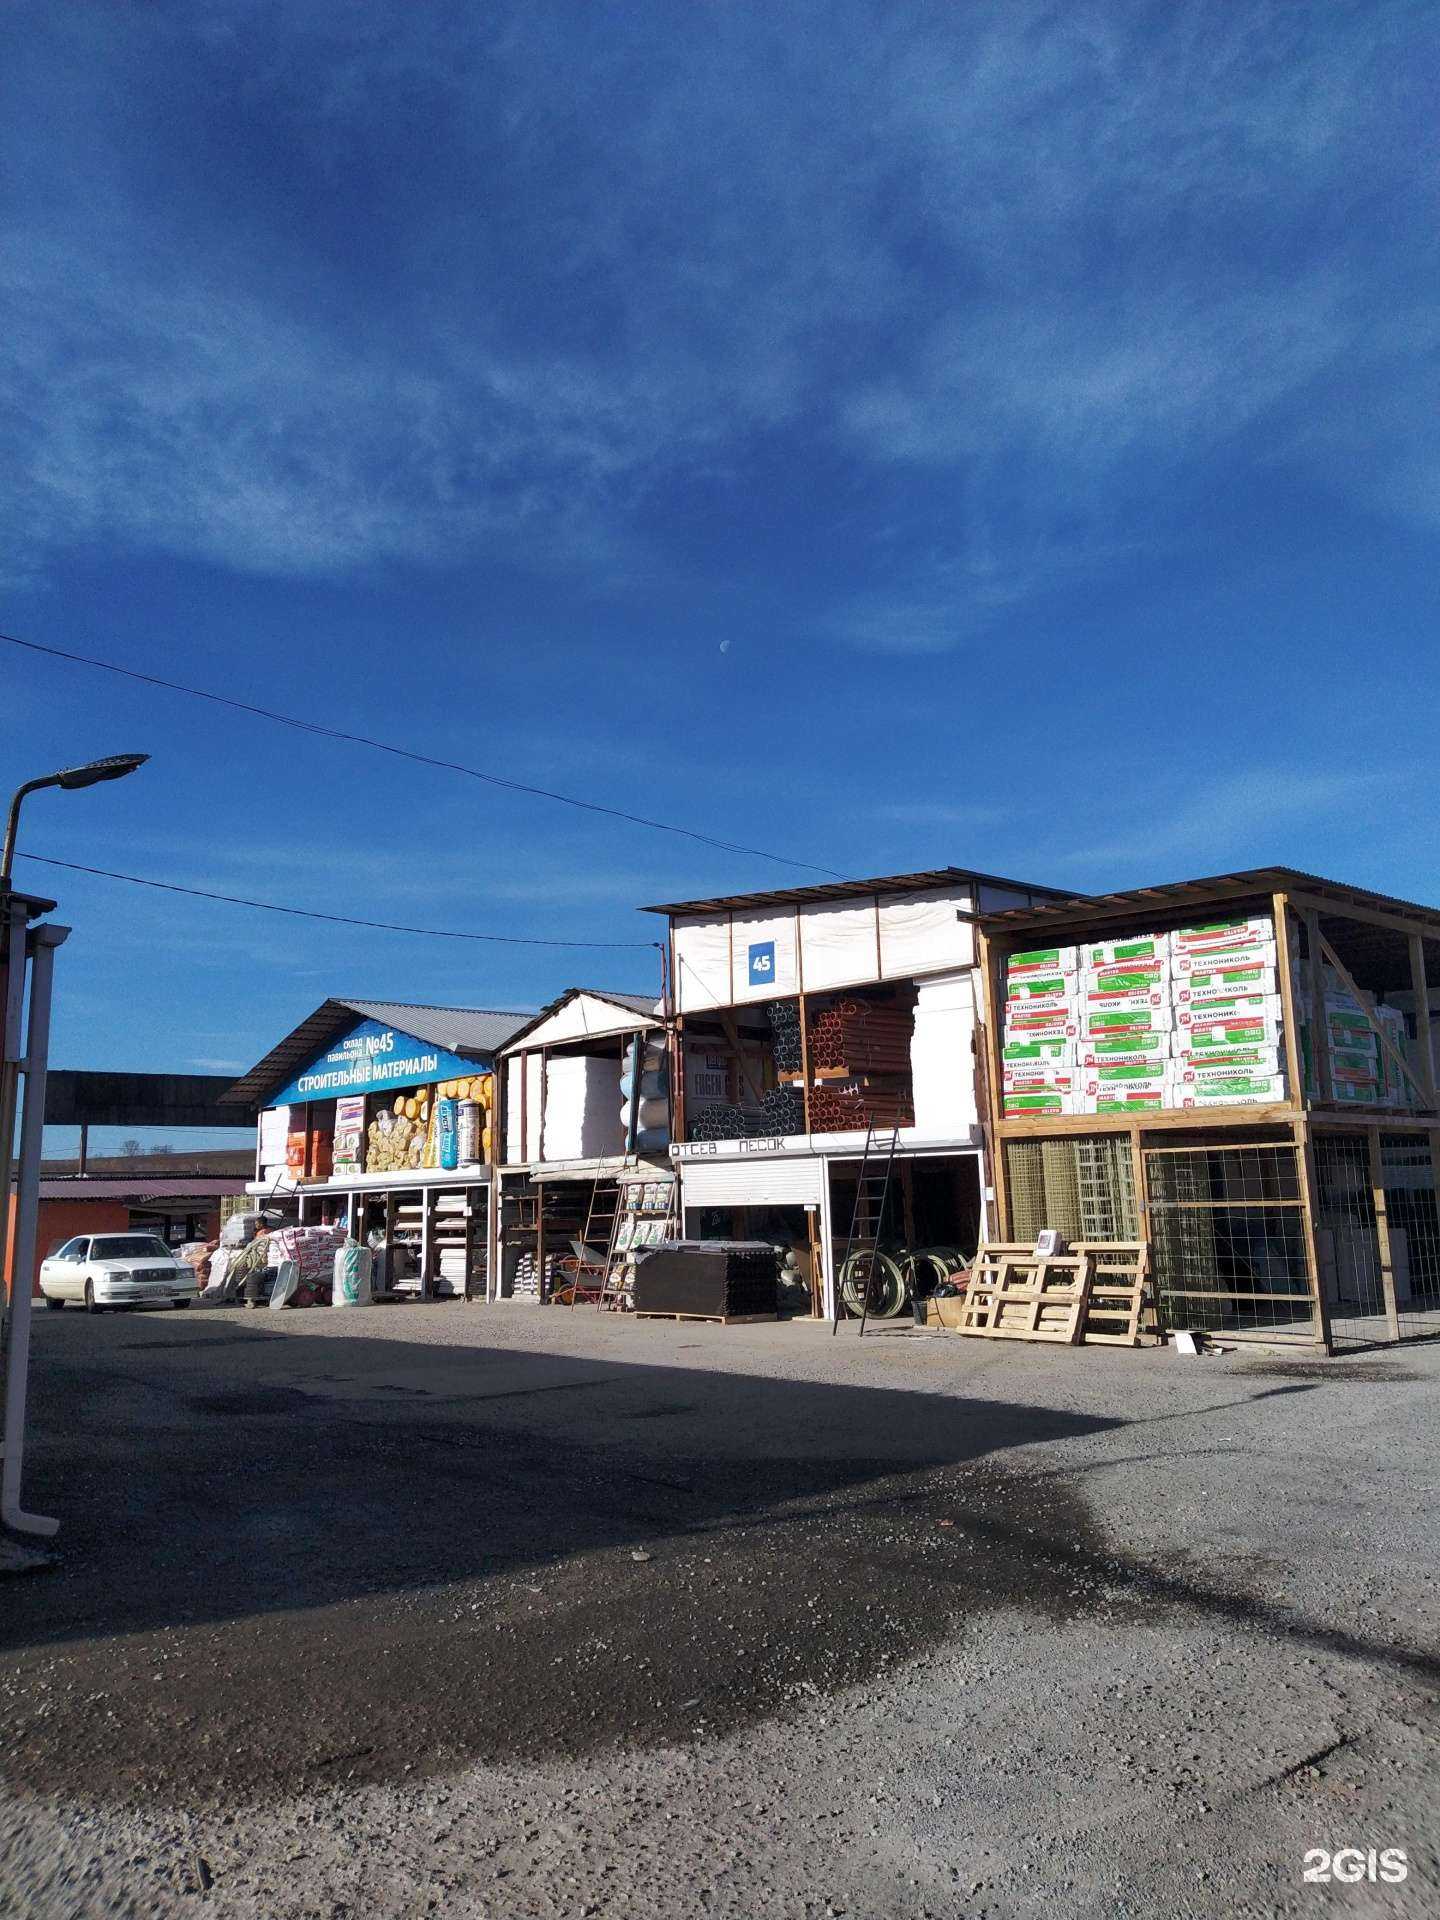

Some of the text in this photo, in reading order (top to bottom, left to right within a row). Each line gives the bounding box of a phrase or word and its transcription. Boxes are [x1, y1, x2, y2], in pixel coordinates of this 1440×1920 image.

[753, 955, 771, 972] 45
[1194, 955, 1250, 967] ТЕХНОНИКОЛЬ
[1193, 986, 1248, 997] ТЕХНОИКОЛЬ
[343, 1032, 394, 1054] склад №45
[327, 1049, 363, 1063] павильона
[298, 1054, 438, 1092] СТРОИТЕЛЬНЫЕ МАТЕРИАЛЫ
[671, 1138, 786, 1157] ОТСЕВ ПЕСОК
